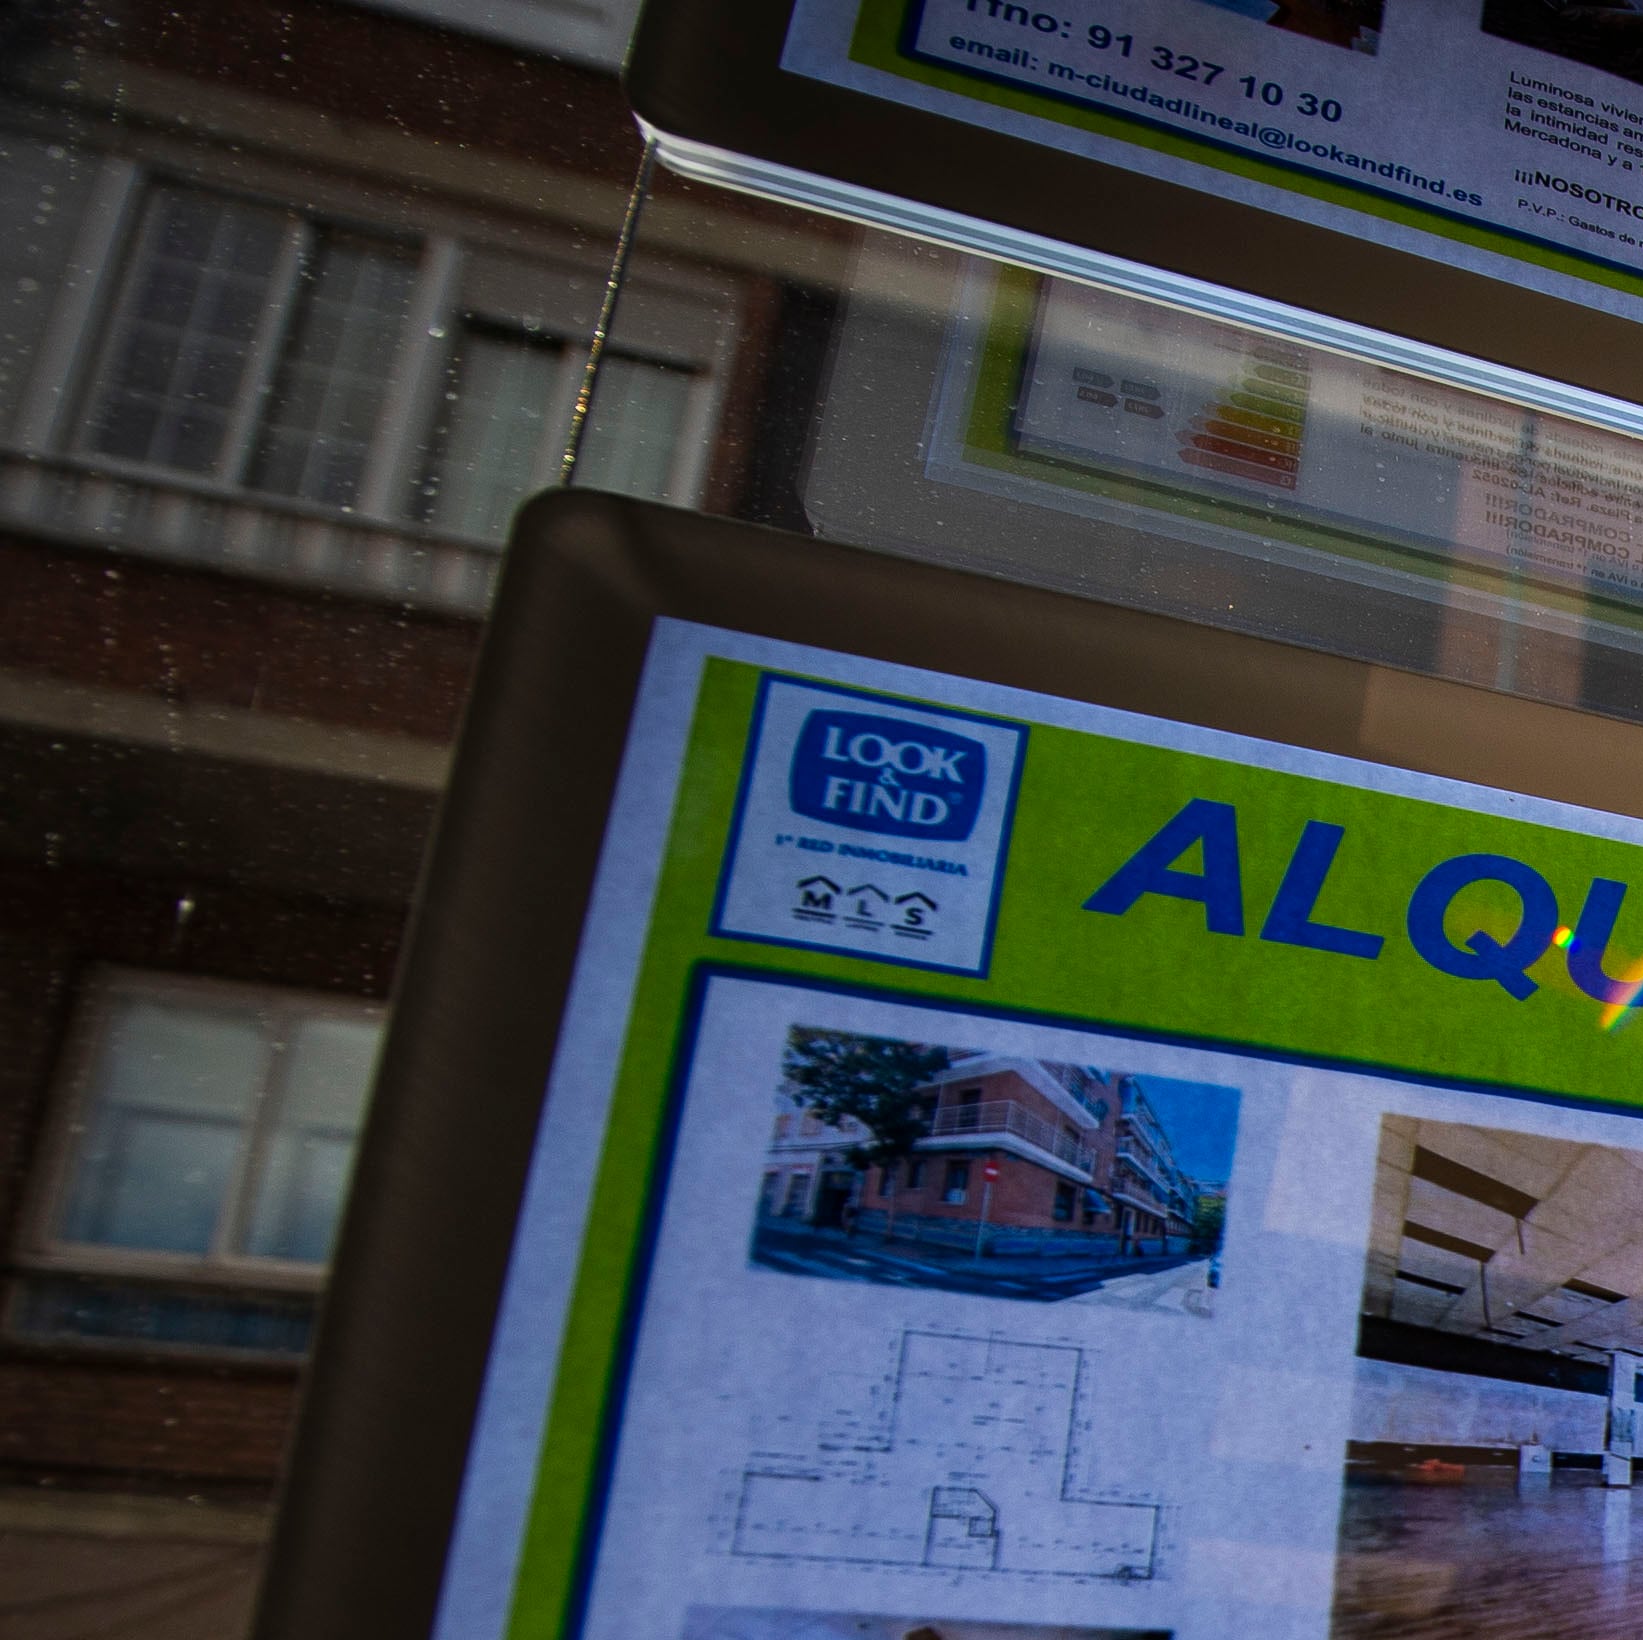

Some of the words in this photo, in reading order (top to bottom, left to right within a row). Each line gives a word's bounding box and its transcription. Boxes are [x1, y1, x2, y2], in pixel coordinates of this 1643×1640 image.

[1087, 24, 1134, 59] 91
[1150, 45, 1225, 87] 327
[1238, 74, 1284, 107] 10
[1296, 92, 1342, 124] 30
[1510, 71, 1594, 108] Luminosa
[949, 34, 1039, 71] email:
[1047, 62, 1483, 208] m-ciudadlineal@lookandfind.es
[821, 726, 968, 784] LOOK
[879, 767, 901, 788] &
[823, 775, 950, 826] FIND
